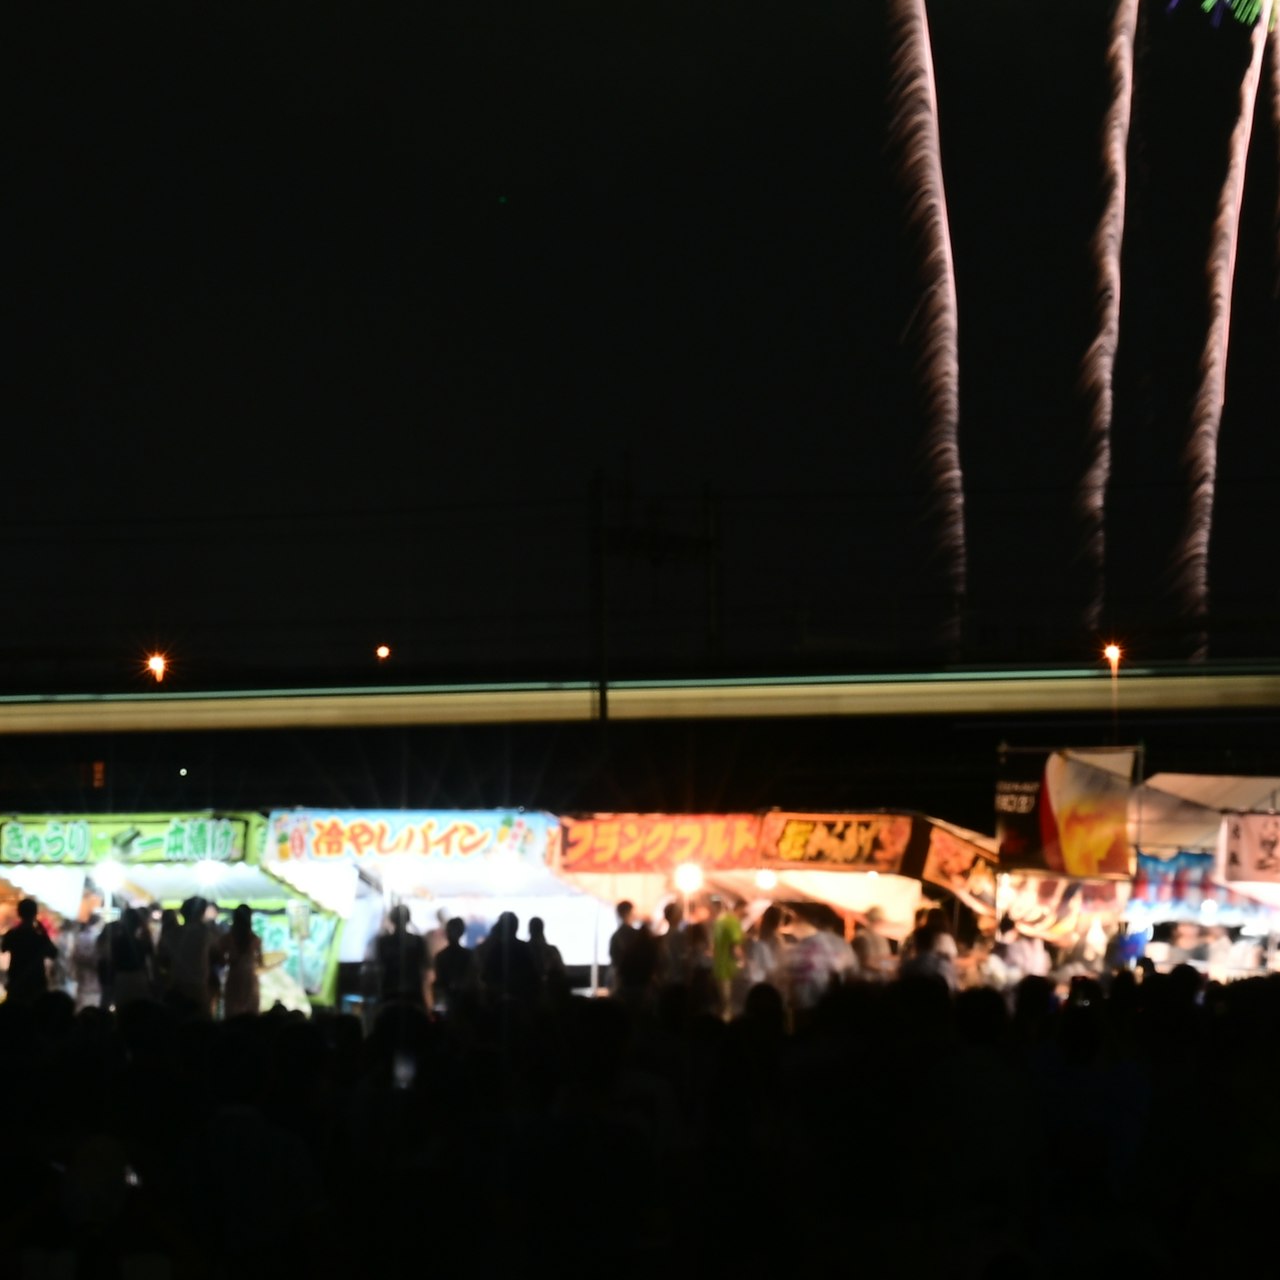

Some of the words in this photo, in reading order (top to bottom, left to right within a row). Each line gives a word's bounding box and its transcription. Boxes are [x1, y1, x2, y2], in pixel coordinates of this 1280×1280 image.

[1, 820, 91, 862] きゅうり
[134, 817, 237, 861] 一本漬け
[311, 818, 490, 856] 冷やしパイン
[569, 821, 757, 862] フランクフルト
